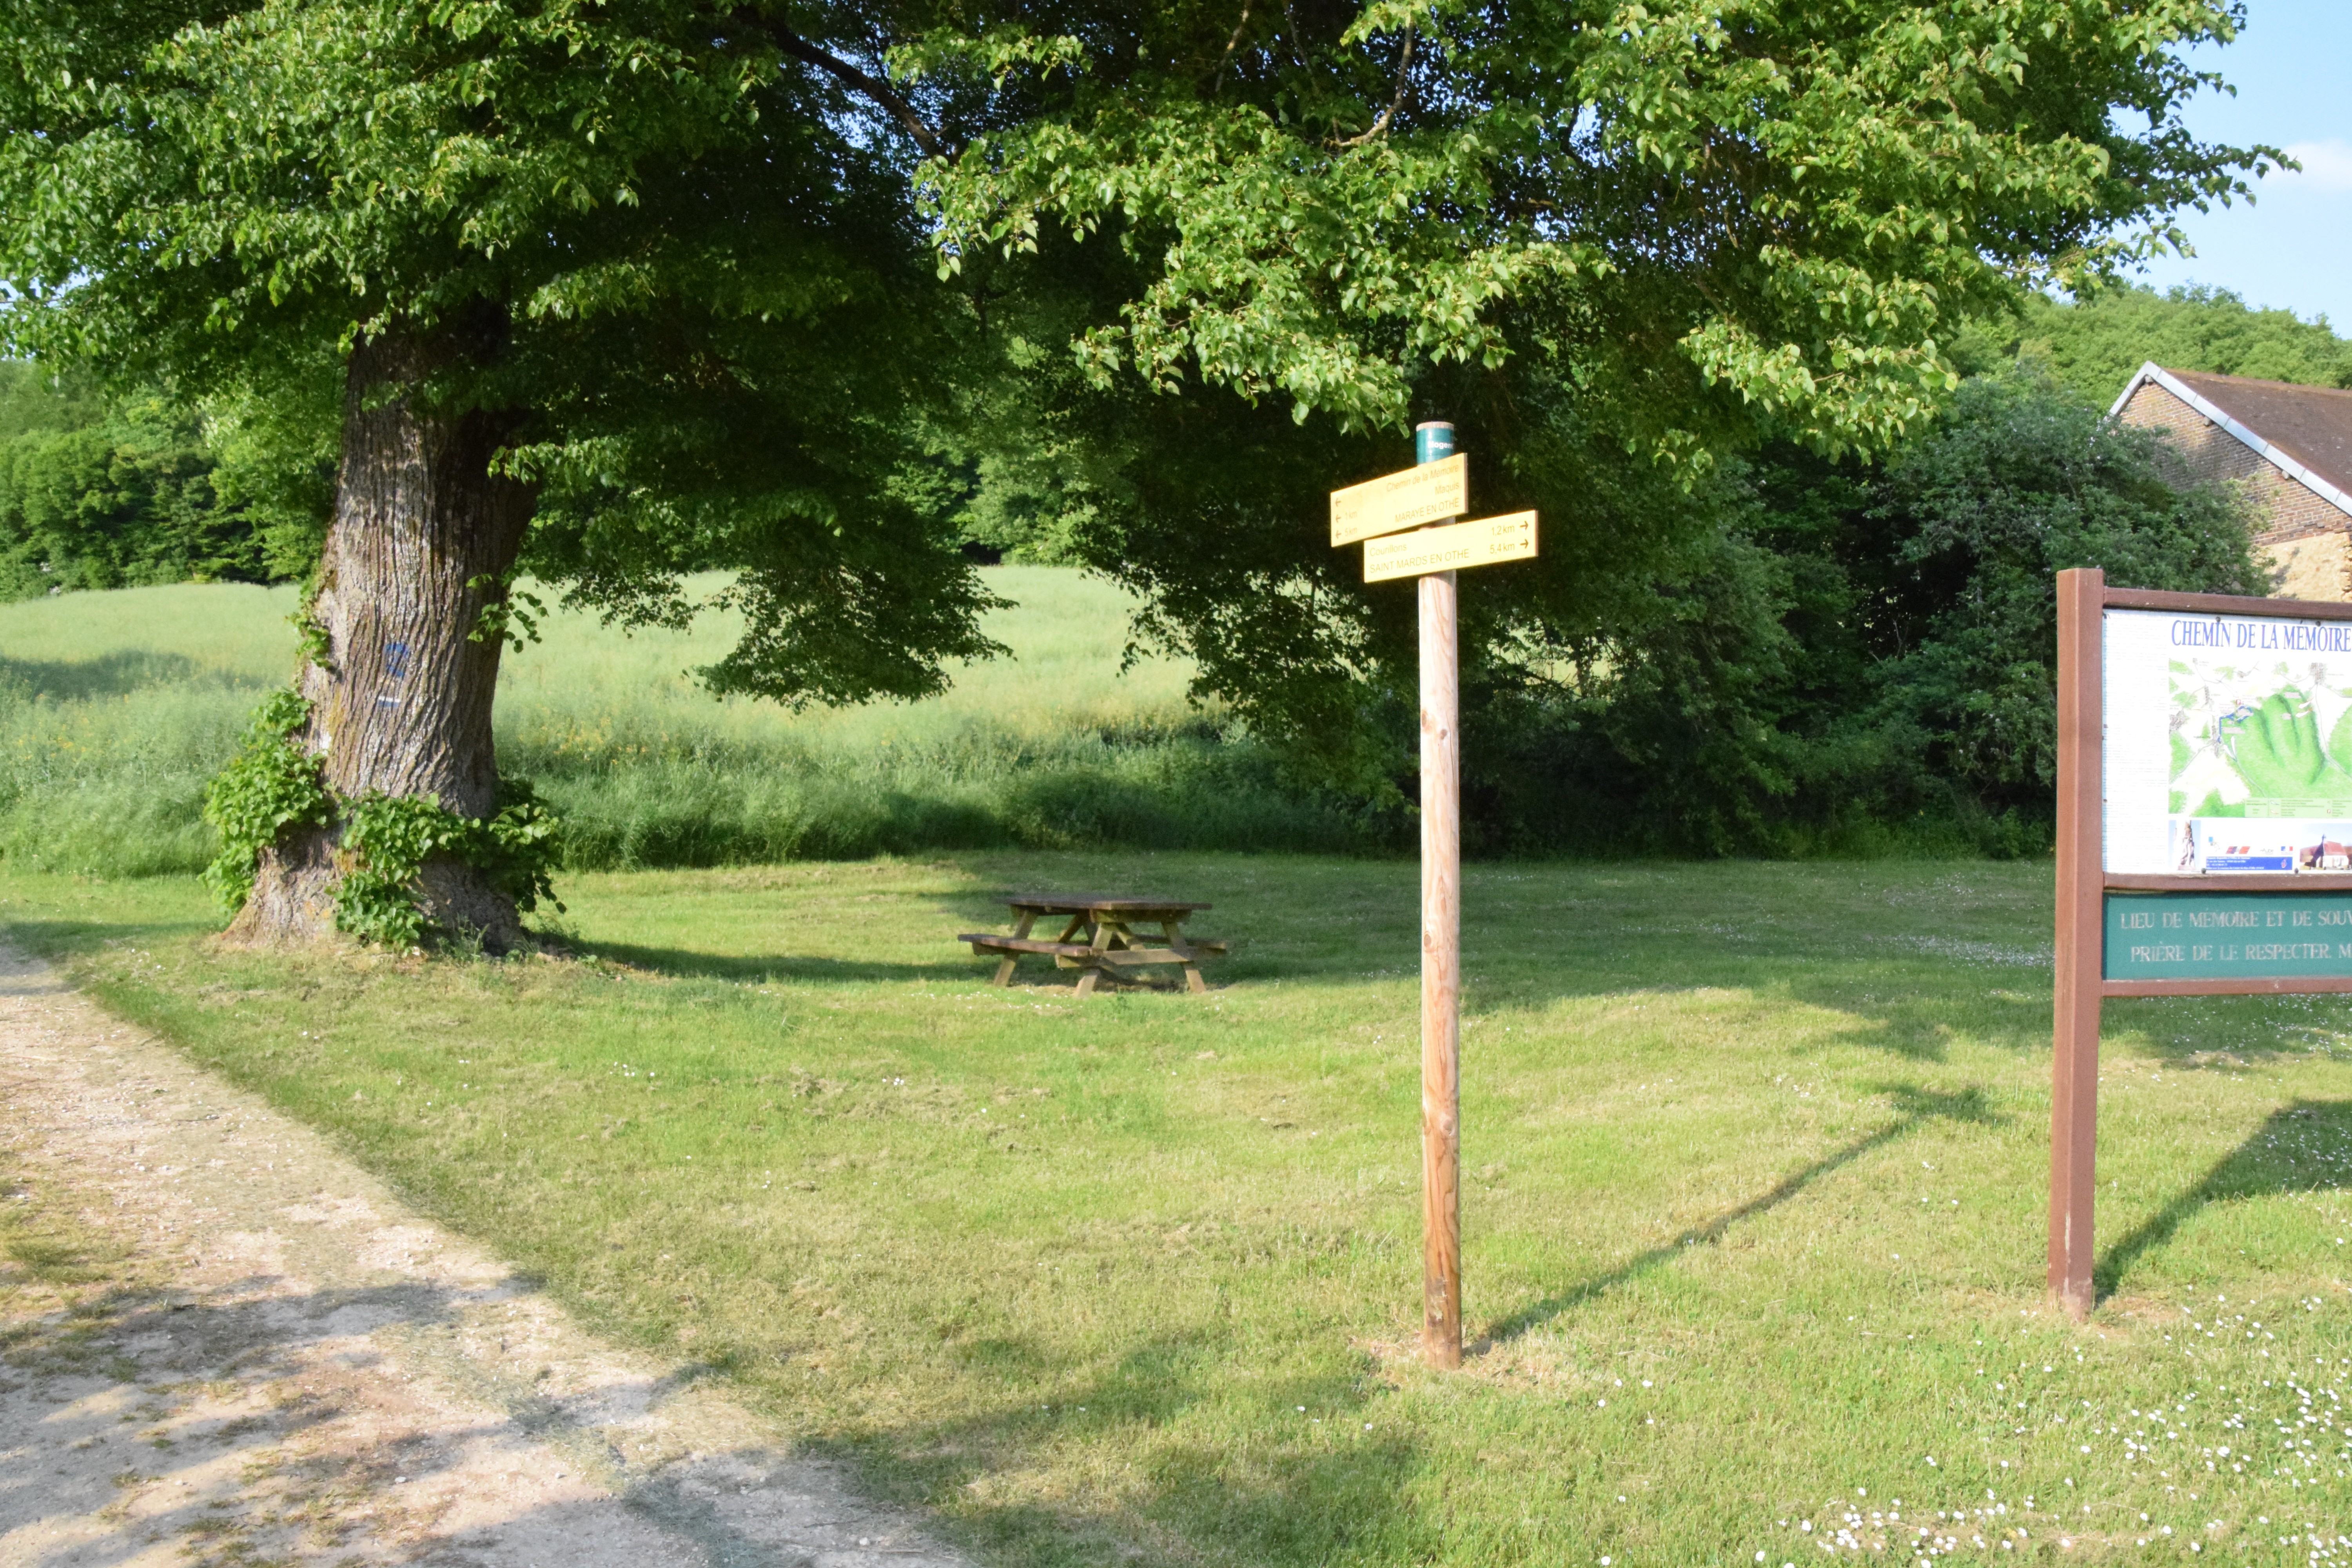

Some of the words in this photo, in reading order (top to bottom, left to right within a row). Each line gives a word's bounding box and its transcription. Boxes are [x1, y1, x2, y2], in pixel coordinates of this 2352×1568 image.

[1387, 478, 1410, 492] Chemin
[1412, 475, 1421, 485] de
[1423, 473, 1428, 481] la
[1430, 465, 1459, 479] Mémoire
[1435, 482, 1459, 495] Maquis
[1395, 507, 1424, 523] MARAYE
[1426, 504, 1436, 515] EN
[1439, 498, 1459, 511] OTHE
[1345, 528, 1348, 536] 5
[1349, 527, 1357, 535] km
[1491, 526, 1501, 536] 1,2
[1503, 525, 1515, 534] km
[1370, 544, 1407, 557] Courillons
[1490, 543, 1502, 555] 5,4
[1503, 543, 1515, 552] km
[1370, 561, 1394, 573] SAINT
[1397, 555, 1427, 568] MARDS
[1430, 554, 1442, 563] EN
[1445, 549, 1469, 561] OTHE
[2171, 620, 2232, 647] CHEMIN
[2236, 623, 2256, 648] DE
[2261, 624, 2278, 649] LA
[2120, 913, 2155, 929] LIEU
[2163, 913, 2182, 928] DE
[2189, 908, 2259, 927] MÉMOIRE
[2266, 911, 2285, 926] ET
[2293, 911, 2312, 926] DE
[2131, 941, 2185, 962] PRIÈRE
[2193, 945, 2212, 960] DE
[2219, 945, 2238, 960] LE
